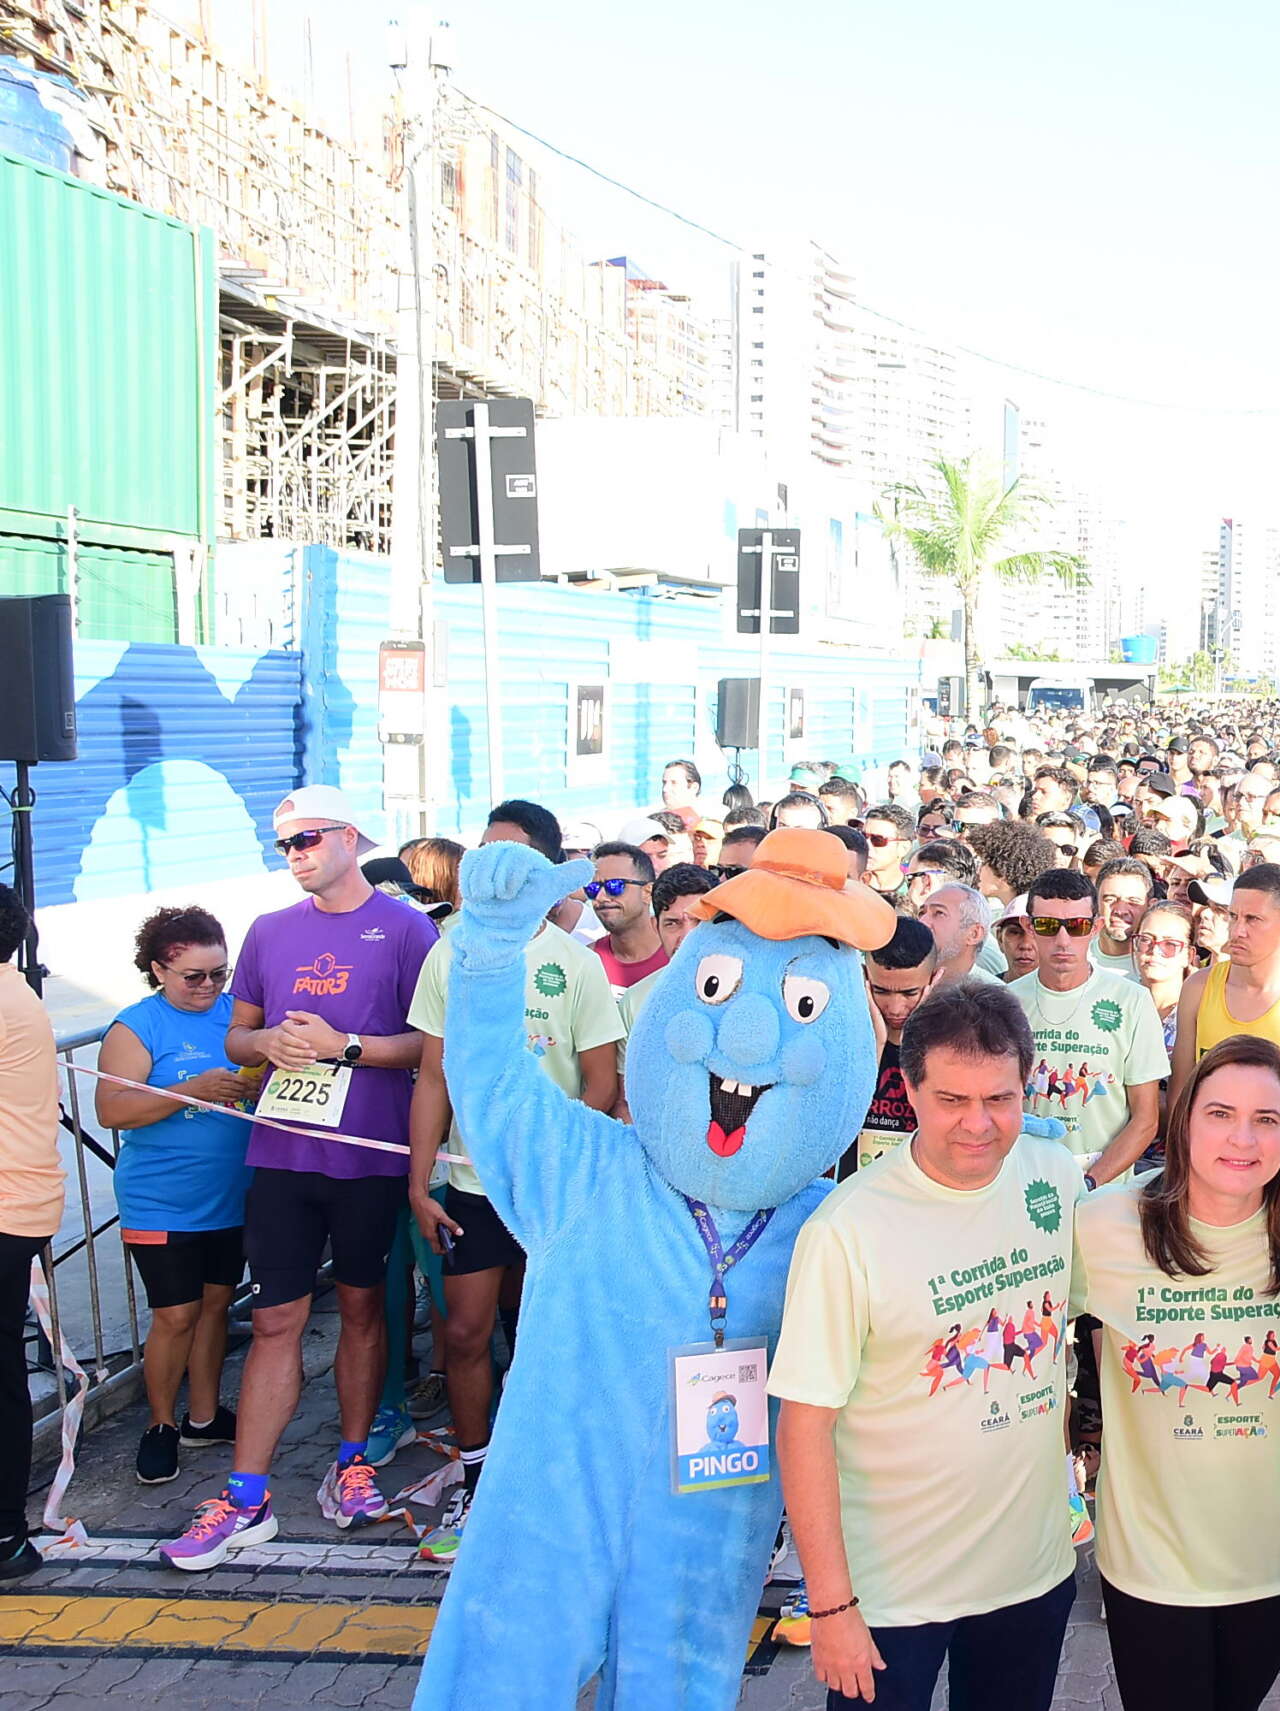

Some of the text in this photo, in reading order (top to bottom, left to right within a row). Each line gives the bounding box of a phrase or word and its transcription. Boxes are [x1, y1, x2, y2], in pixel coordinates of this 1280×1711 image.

[1065, 1030, 1080, 1041] do
[1050, 1041, 1110, 1056] Superação
[276, 1078, 332, 1106] 2225
[879, 1114, 900, 1129] dança
[928, 1247, 1029, 1296] 1ª Corrida do
[932, 1254, 1066, 1316] Esporte Superação
[1137, 1285, 1254, 1304] 1ª Corrida do
[1136, 1303, 1206, 1324] Esporte
[702, 1372, 736, 1384] Cagece
[1020, 1384, 1054, 1405] ESPORTE
[980, 1411, 1011, 1428] CEARÁ
[1217, 1415, 1260, 1424] ESPORTE
[1173, 1426, 1204, 1435] CEARÁ
[689, 1450, 759, 1478] PINGO
